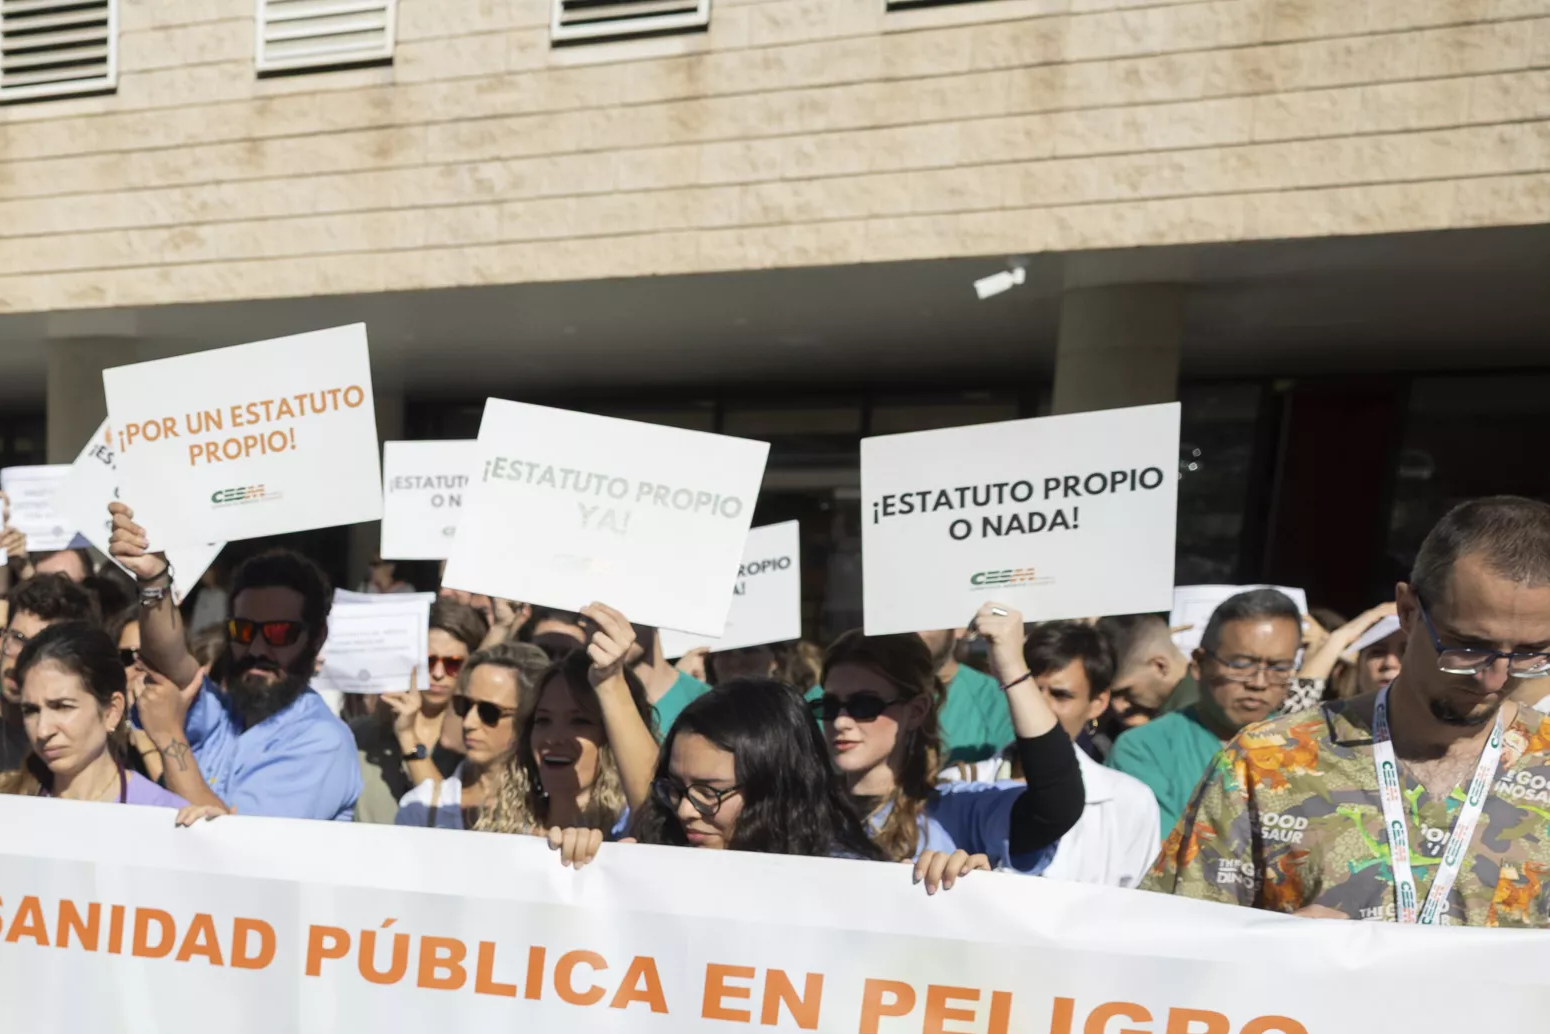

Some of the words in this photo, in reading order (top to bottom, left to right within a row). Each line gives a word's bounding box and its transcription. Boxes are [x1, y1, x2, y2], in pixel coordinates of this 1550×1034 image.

[118, 416, 179, 453] ¡POR
[186, 408, 223, 434] UN
[231, 384, 364, 426] ESTATUTO
[189, 428, 297, 466] PROPIO!
[390, 475, 469, 493] ¡ESTATUT
[482, 457, 629, 500] ¡ESTATUTO
[635, 481, 743, 519] PROPIO
[872, 481, 1033, 524] ¡ESTATUTO
[1044, 466, 1163, 500] PROPIO
[577, 501, 632, 535] YA!
[949, 519, 971, 541] O
[982, 506, 1079, 538] NADA!
[737, 556, 791, 577] ROPIO
[1259, 812, 1308, 830] OOD
[305, 917, 669, 1014] PÚBLICA
[701, 962, 824, 1031] EN
